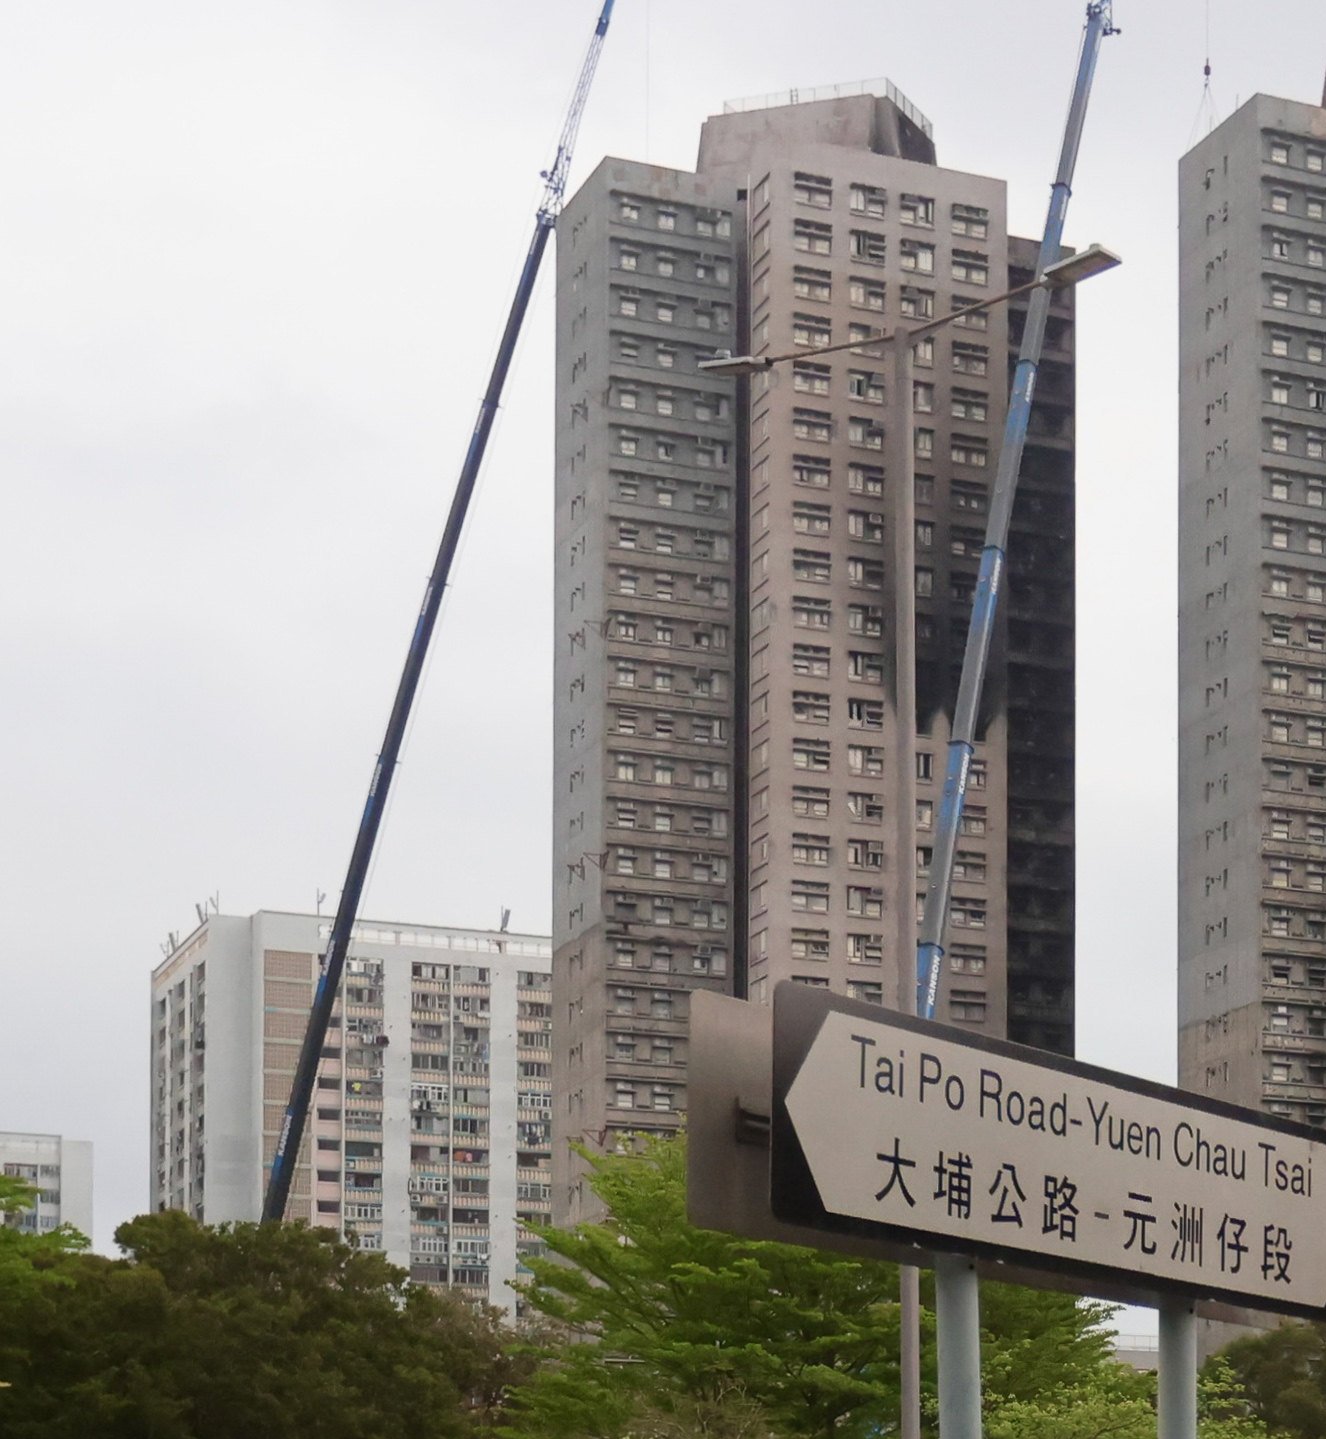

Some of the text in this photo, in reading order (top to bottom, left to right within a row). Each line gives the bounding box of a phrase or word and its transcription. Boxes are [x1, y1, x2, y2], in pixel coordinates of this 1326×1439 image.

[928, 955, 941, 1005] KANBON
[850, 1035, 1313, 1198] Tai Po Road-Yuen Chau Tsai
[874, 1137, 1293, 1286] 大埔公路-元洲仔段
